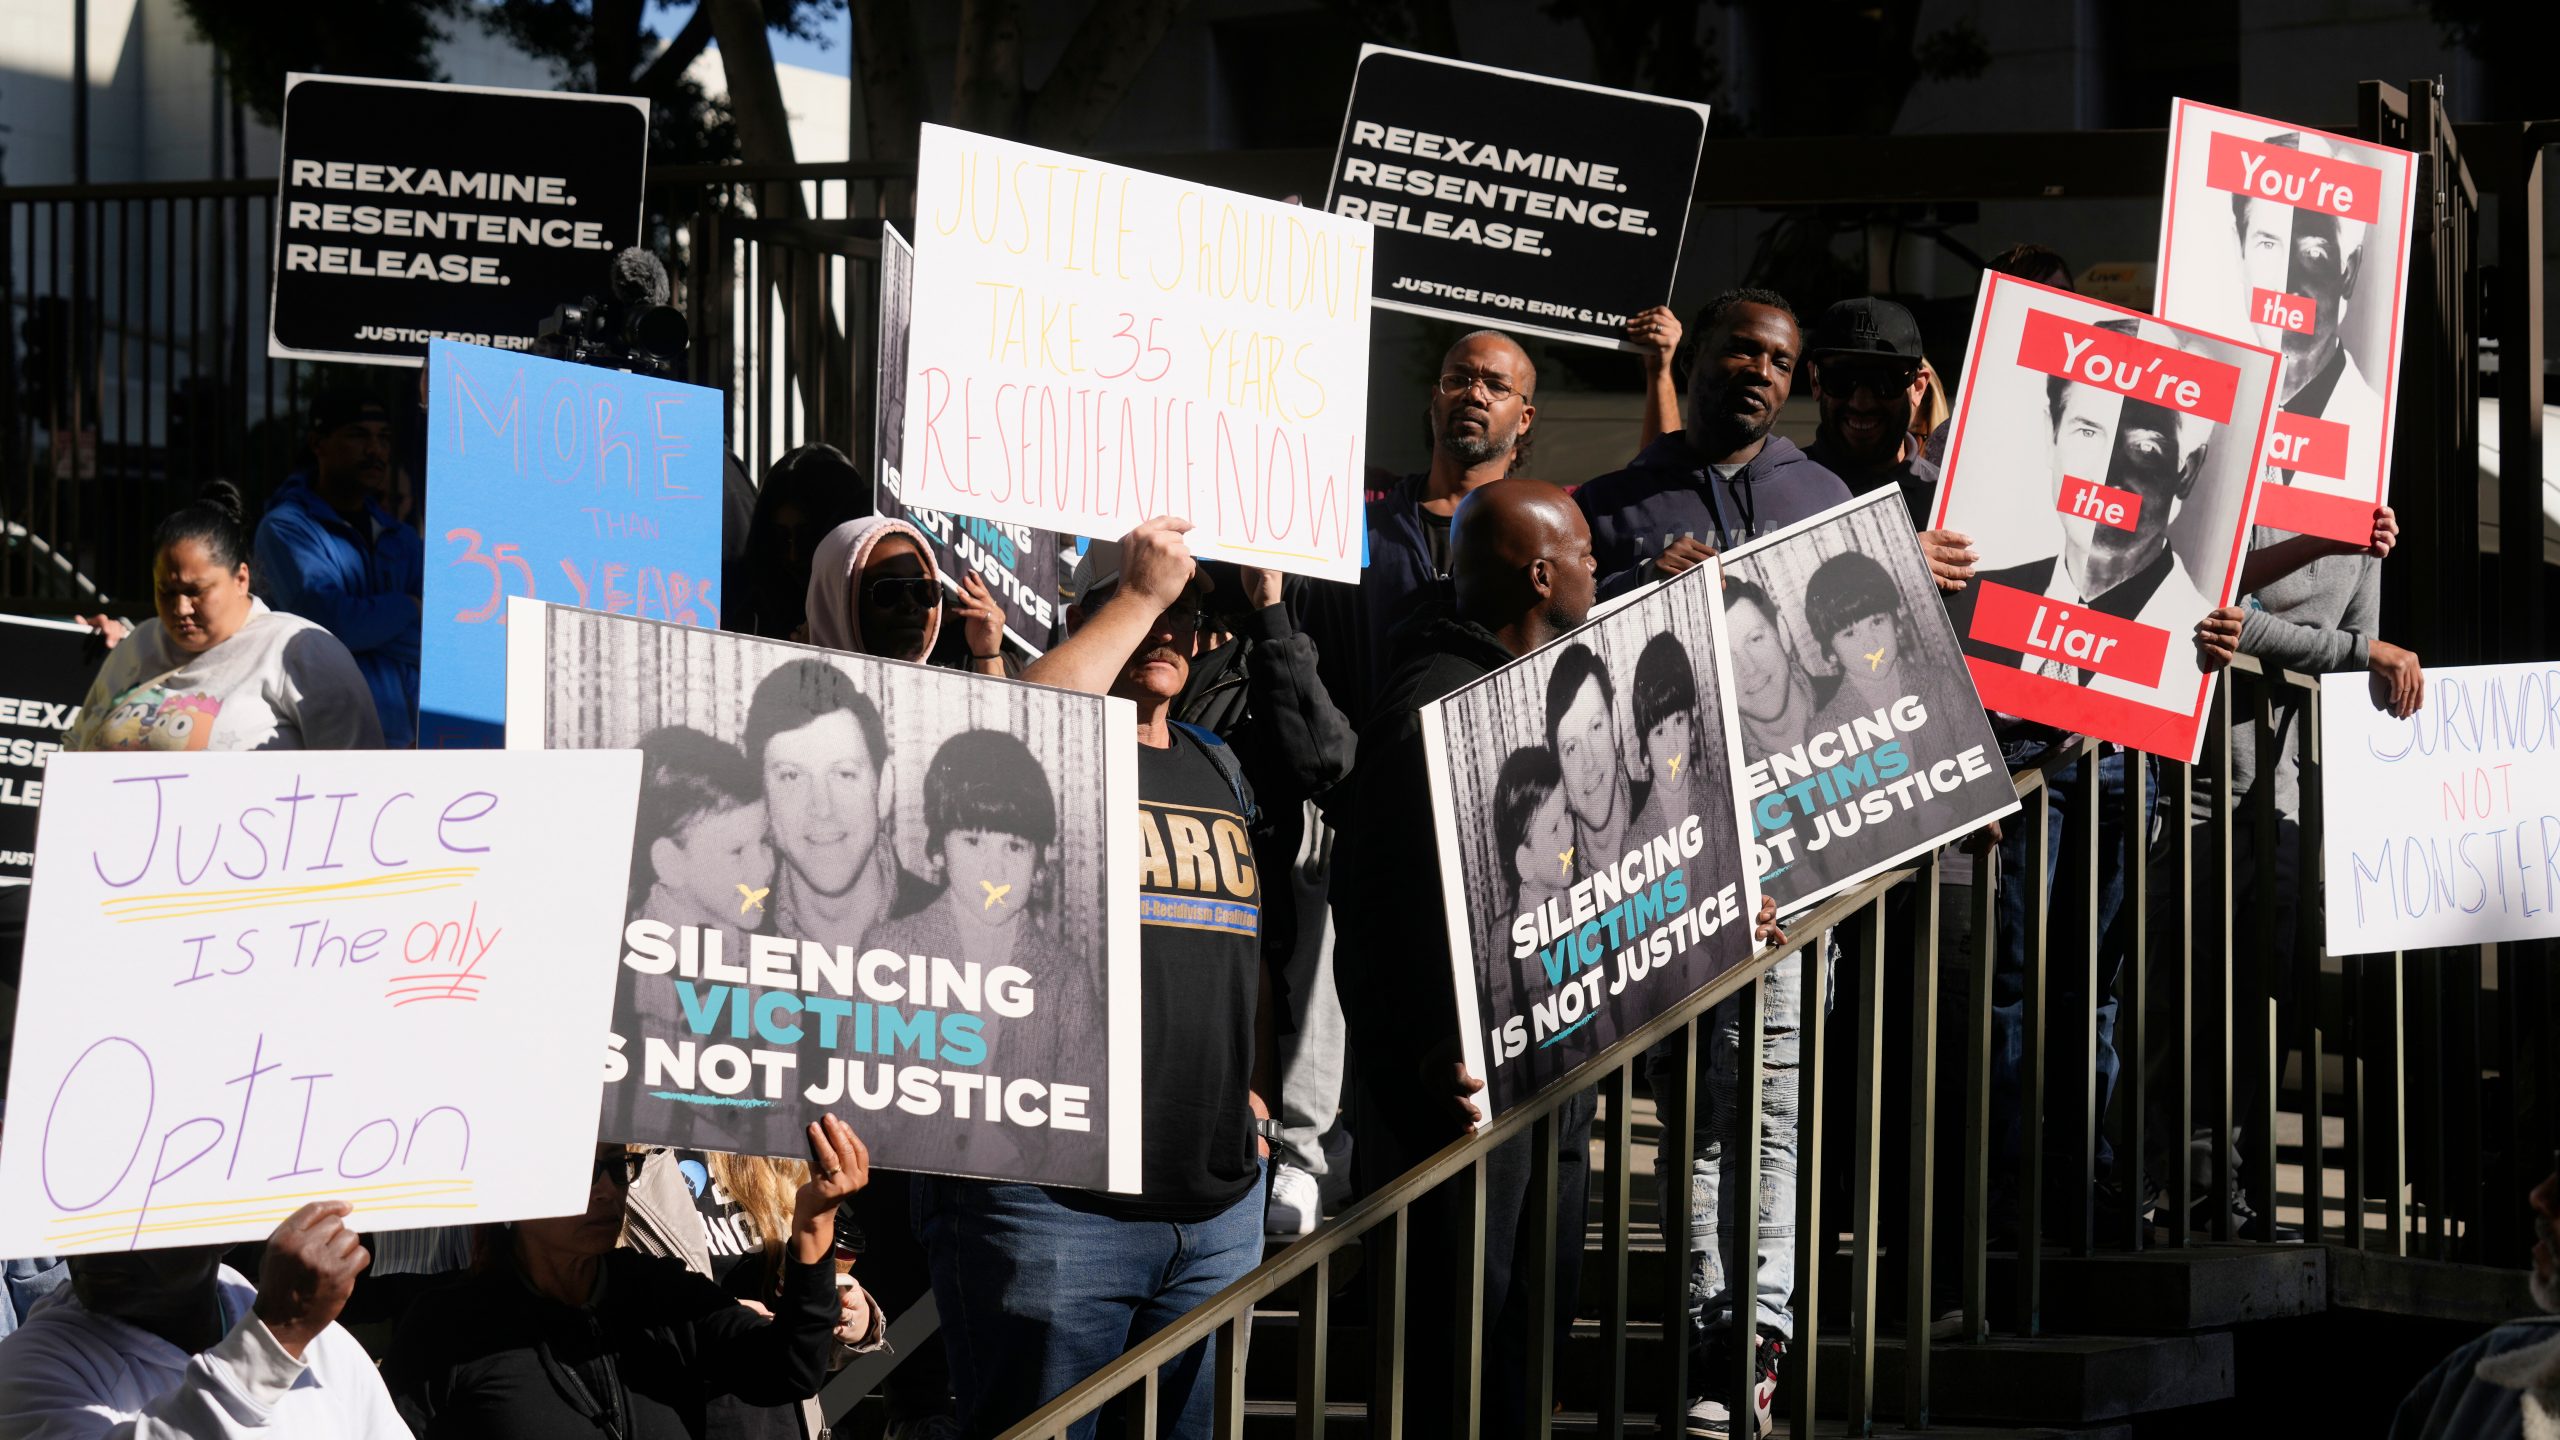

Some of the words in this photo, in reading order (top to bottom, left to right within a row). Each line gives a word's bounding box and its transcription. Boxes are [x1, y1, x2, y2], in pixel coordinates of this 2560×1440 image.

[292, 159, 577, 206] REEXAMINE.
[1351, 120, 1627, 193] REEXAMINE.
[2239, 150, 2354, 213] You're
[289, 202, 614, 251] RESENTENCE.
[936, 151, 1132, 280] JUSTICE
[1335, 194, 1552, 258] RELEASE.
[1343, 158, 1657, 237] RESENTENCE.
[286, 244, 511, 286] RELEASE.
[1392, 277, 1480, 303] JUSTICE
[1481, 291, 1526, 311] FOR
[1526, 300, 1576, 320] ERIK
[1578, 308, 1593, 322] &
[354, 326, 444, 343] JUSTICE
[976, 281, 1086, 376] TAKE
[1095, 312, 1172, 381] 35
[1200, 325, 1325, 423] YEARS
[2262, 297, 2304, 330] the
[2060, 331, 2202, 409] You're
[445, 352, 704, 500] MORE
[1217, 410, 1355, 558] NOW
[2074, 485, 2125, 525] the
[581, 508, 660, 540] THAN
[445, 528, 536, 624] 35
[954, 533, 1052, 629] JUSTICE
[2026, 604, 2118, 664] Liar
[1806, 744, 1992, 851] JUSTICE
[2443, 763, 2513, 821] NOT
[1138, 809, 1256, 897] ARC
[1512, 815, 1704, 959] SILENCING
[1540, 869, 1687, 986] VICTIMS
[623, 919, 1034, 1018] SILENCING
[1491, 1015, 1528, 1067] IS
[1532, 965, 1604, 1042] NOT
[1609, 882, 1740, 995] JUSTICE
[675, 980, 987, 1066] VICTIMS
[644, 1037, 797, 1099] NOT
[804, 1057, 1091, 1133] JUSTICE
